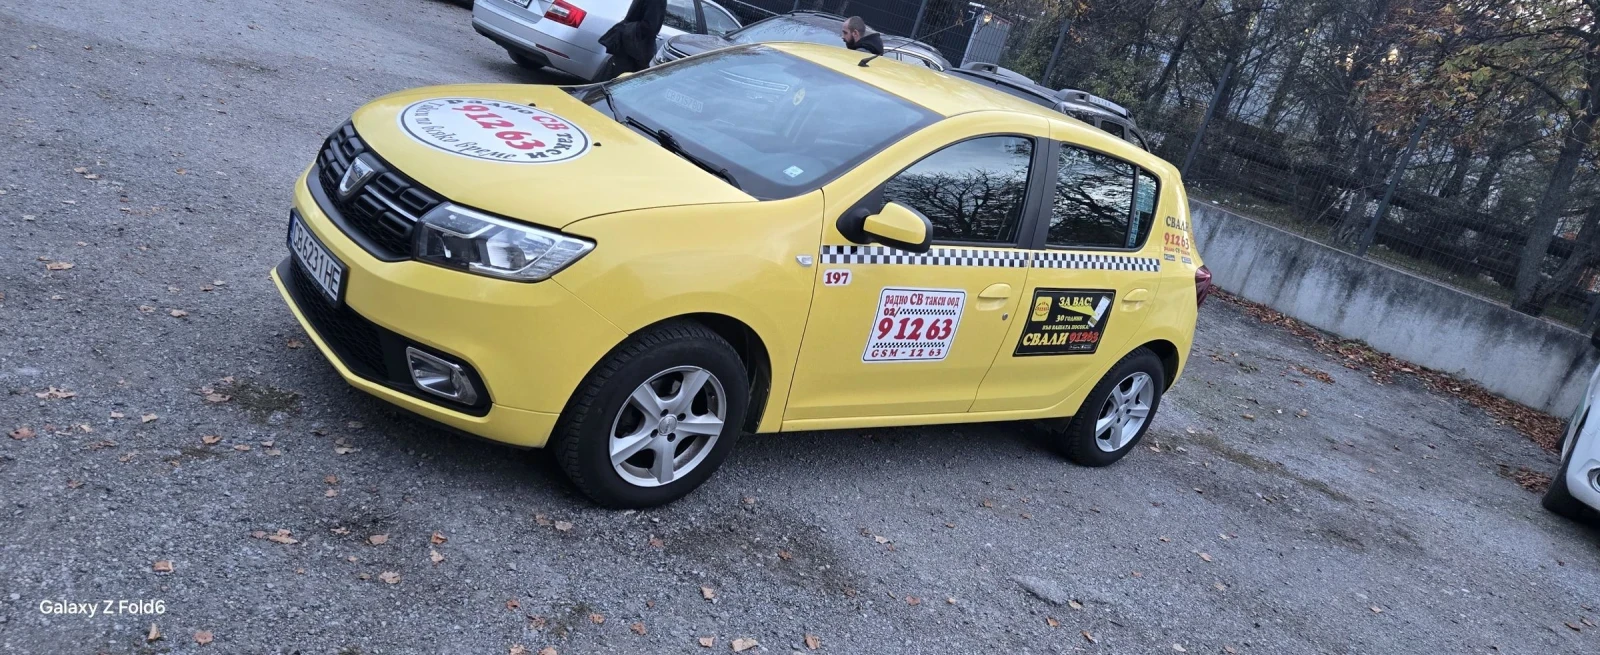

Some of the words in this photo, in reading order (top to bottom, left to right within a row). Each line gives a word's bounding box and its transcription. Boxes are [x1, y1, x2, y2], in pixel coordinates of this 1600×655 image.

[454, 139, 517, 160] време
[1164, 232, 1190, 250] 91263
[824, 271, 849, 284] 197
[884, 294, 908, 307] радио
[909, 293, 924, 306] СВ
[925, 296, 946, 306] такси
[946, 297, 960, 308] оод
[1058, 296, 1071, 306] ЗА
[1055, 314, 1064, 322] 30
[1022, 332, 1069, 346] СВАЛИ
[909, 348, 924, 357] 12
[928, 348, 942, 357] 63
